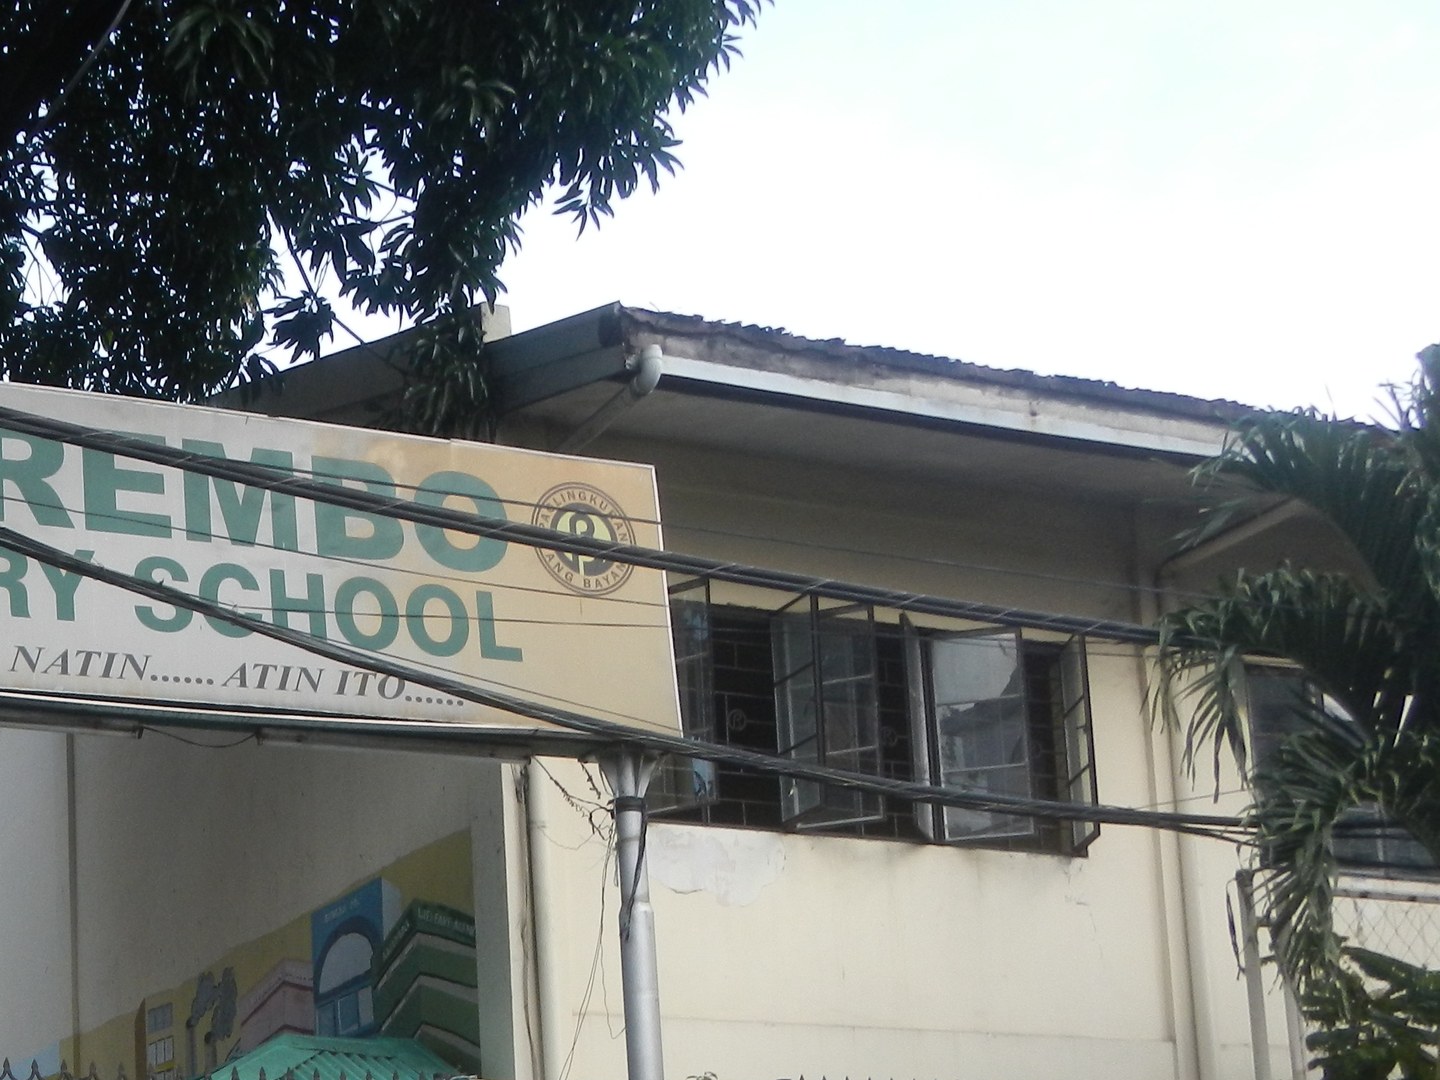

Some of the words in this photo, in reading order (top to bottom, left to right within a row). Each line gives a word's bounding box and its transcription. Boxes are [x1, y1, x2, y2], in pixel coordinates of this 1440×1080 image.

[545, 552, 574, 583] ANG
[583, 563, 627, 589] BAYAN
[134, 555, 523, 664] SCHOOL
